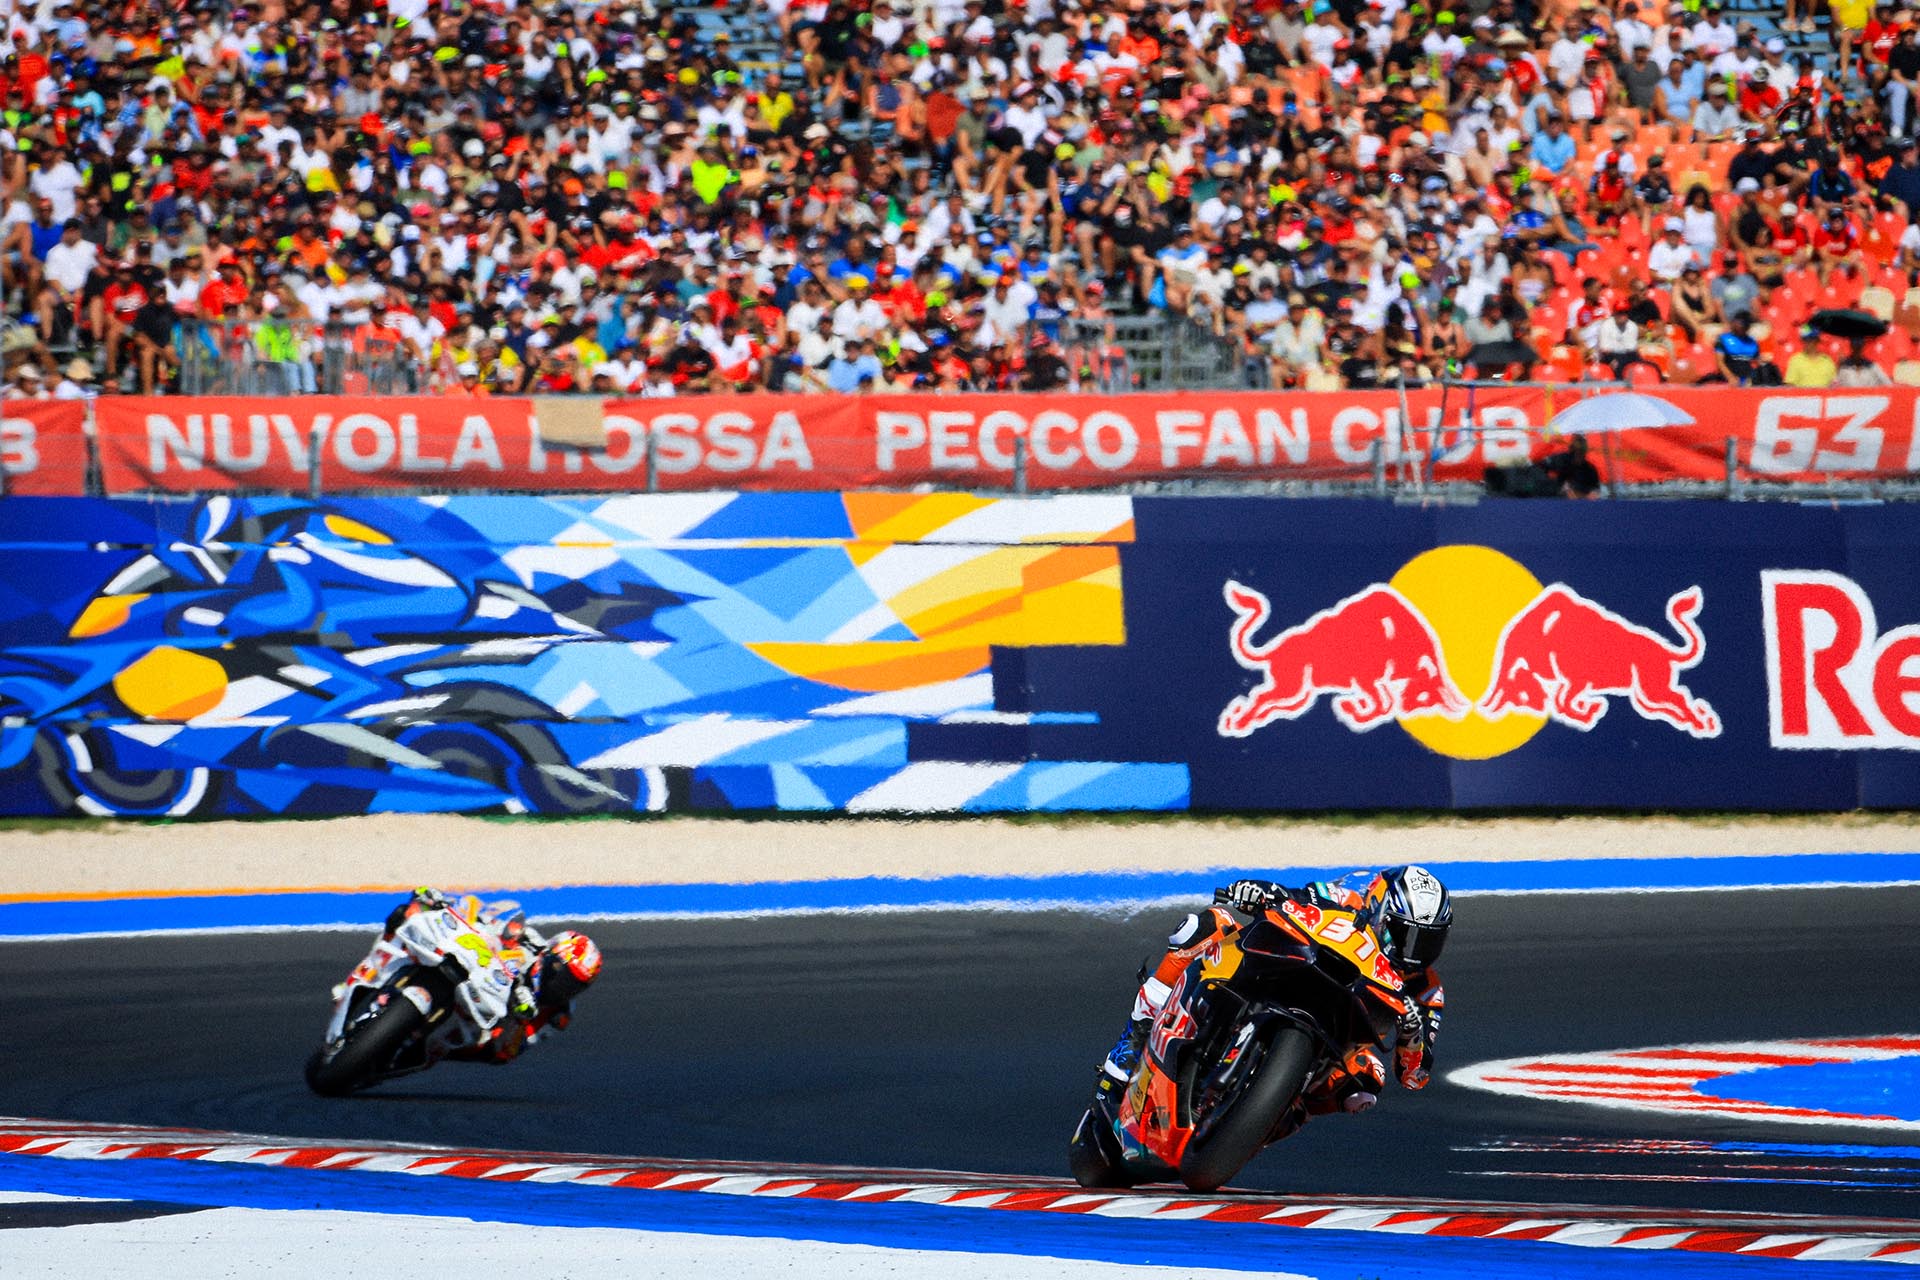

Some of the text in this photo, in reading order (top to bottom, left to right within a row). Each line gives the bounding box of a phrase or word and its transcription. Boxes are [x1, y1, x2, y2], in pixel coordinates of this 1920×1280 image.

[146, 413, 502, 473] NUVOLA
[875, 406, 1530, 470] PECCO FAN CLUB
[1751, 395, 1890, 474] 63
